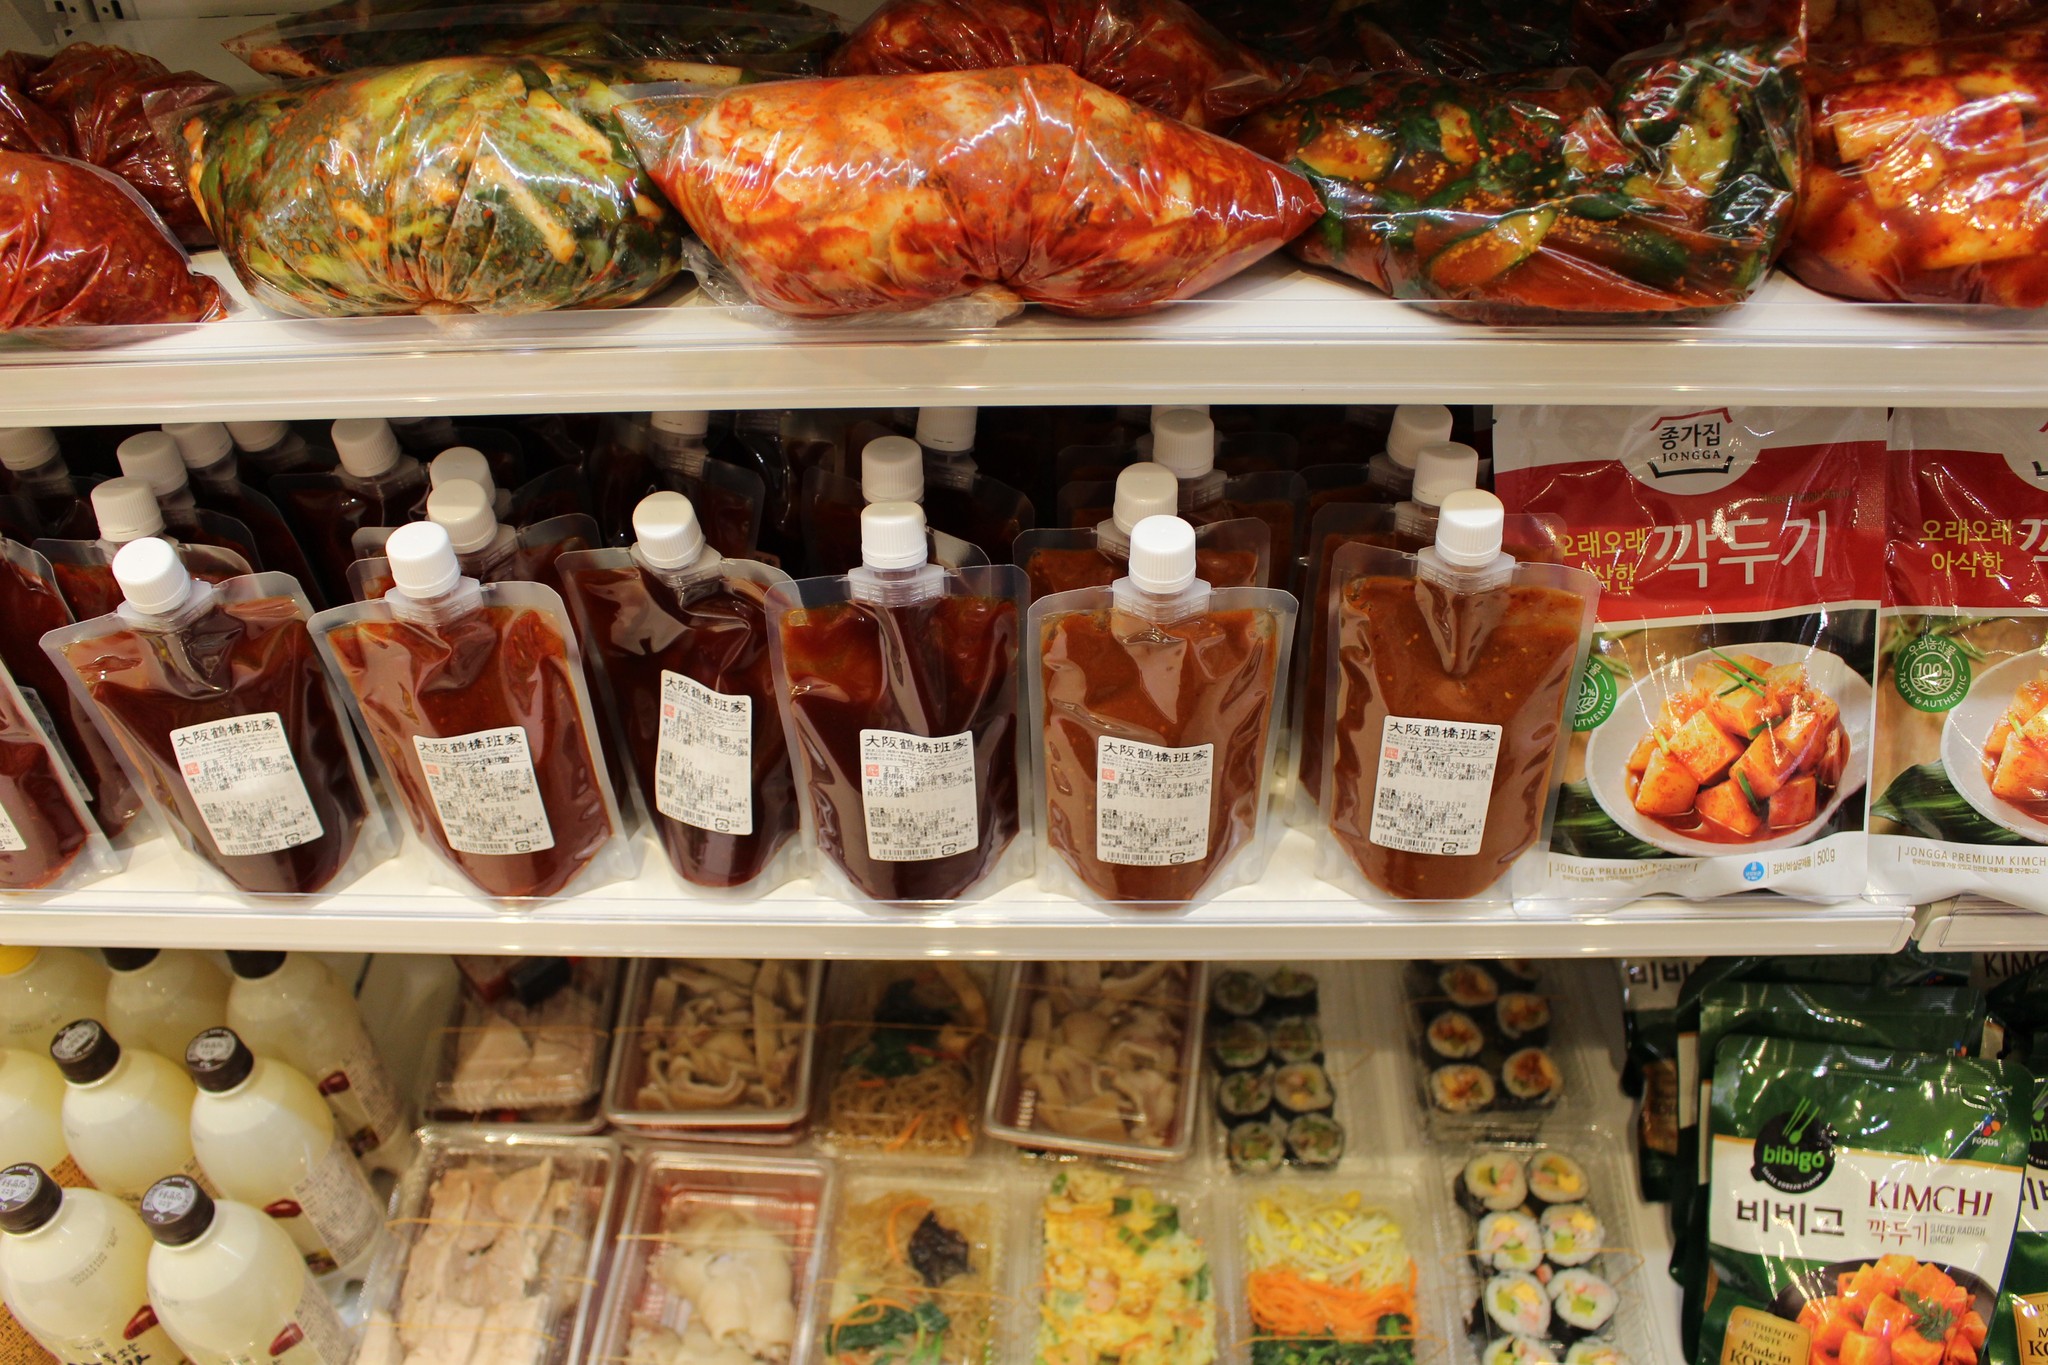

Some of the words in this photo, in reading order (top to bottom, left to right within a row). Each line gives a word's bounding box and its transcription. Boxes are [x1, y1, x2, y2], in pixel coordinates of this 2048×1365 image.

[1659, 422, 1720, 450] 종가집
[1662, 450, 1721, 463] JONGGA
[1561, 527, 1647, 559] 오래오래
[1919, 519, 2012, 545] 오래오래
[1653, 510, 1828, 588] 깍두기
[1581, 561, 1636, 592] 삭한
[1931, 551, 2004, 578] 아삭한
[1908, 637, 1957, 657] 우리농산물
[1899, 671, 1916, 698] TASTY
[1915, 696, 1922, 704] &
[1922, 675, 1967, 708] AUTHENTIC
[1574, 693, 1612, 727] UTHENTIC
[864, 735, 968, 754] 大阪鶴橋班家
[1388, 722, 1497, 742] 大阪鶴橋班家
[1103, 741, 1208, 763] 大阪鶴橋班家
[1555, 863, 1595, 876] JONGGA
[1599, 864, 1648, 875] PREMIUM
[1904, 846, 1949, 860] JONGGA
[1952, 852, 2004, 866] PREMIUM
[2009, 856, 2047, 867] KIMCH
[1972, 1137, 1999, 1147] FOODS
[1763, 1144, 1825, 1173] bibigo
[1869, 1180, 1993, 1216] KIMCHI
[1737, 1199, 1845, 1236] 비비고
[1958, 1225, 1986, 1236] RADISH
[1867, 1220, 1928, 1247] 깍두기
[1742, 1340, 1776, 1359] Made
[1778, 1353, 1791, 1364] in
